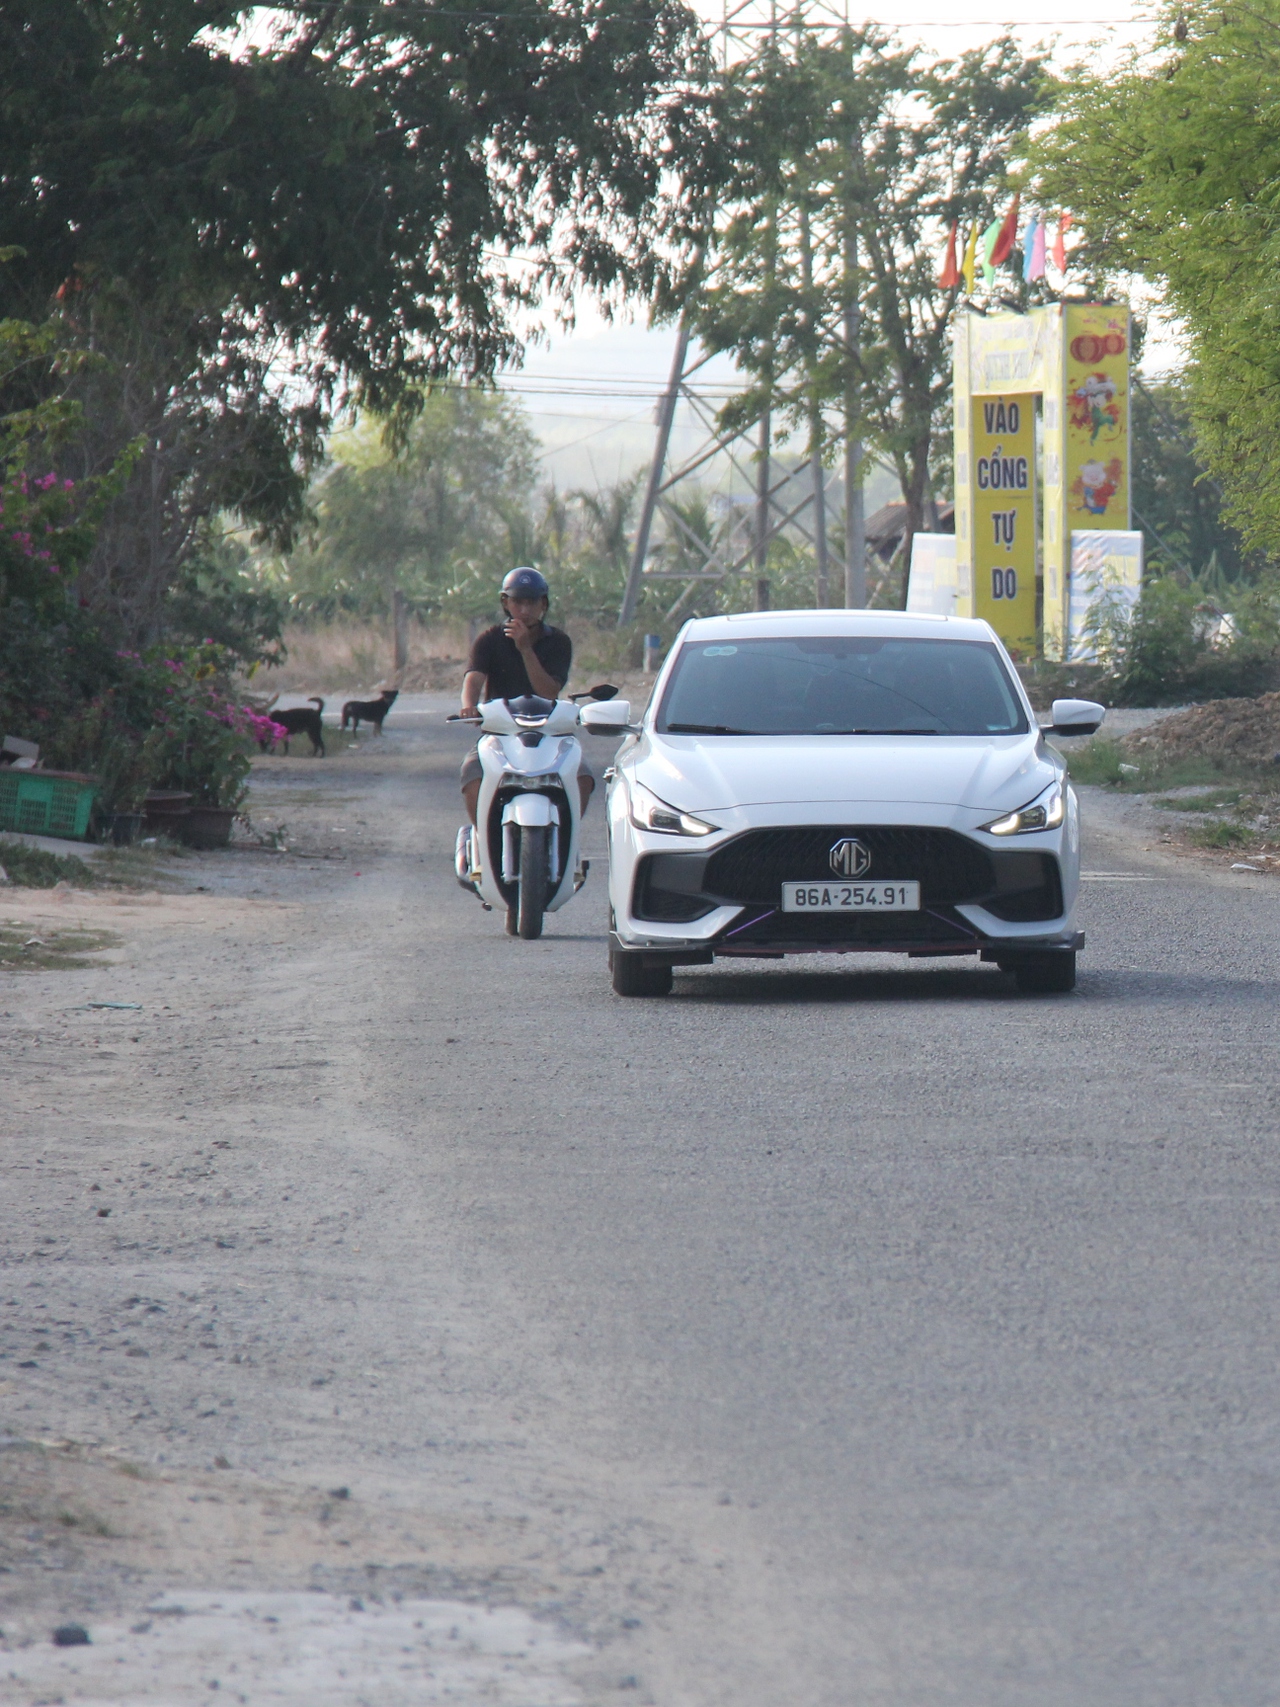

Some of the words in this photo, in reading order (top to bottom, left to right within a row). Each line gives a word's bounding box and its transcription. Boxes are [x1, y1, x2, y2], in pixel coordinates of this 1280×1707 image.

[983, 396, 1020, 434] VÀO
[976, 445, 1028, 490] CỔNG
[991, 509, 1017, 552] TỰ
[991, 567, 1018, 600] DO
[833, 841, 867, 876] MG
[795, 887, 906, 907] 86A-254.91
